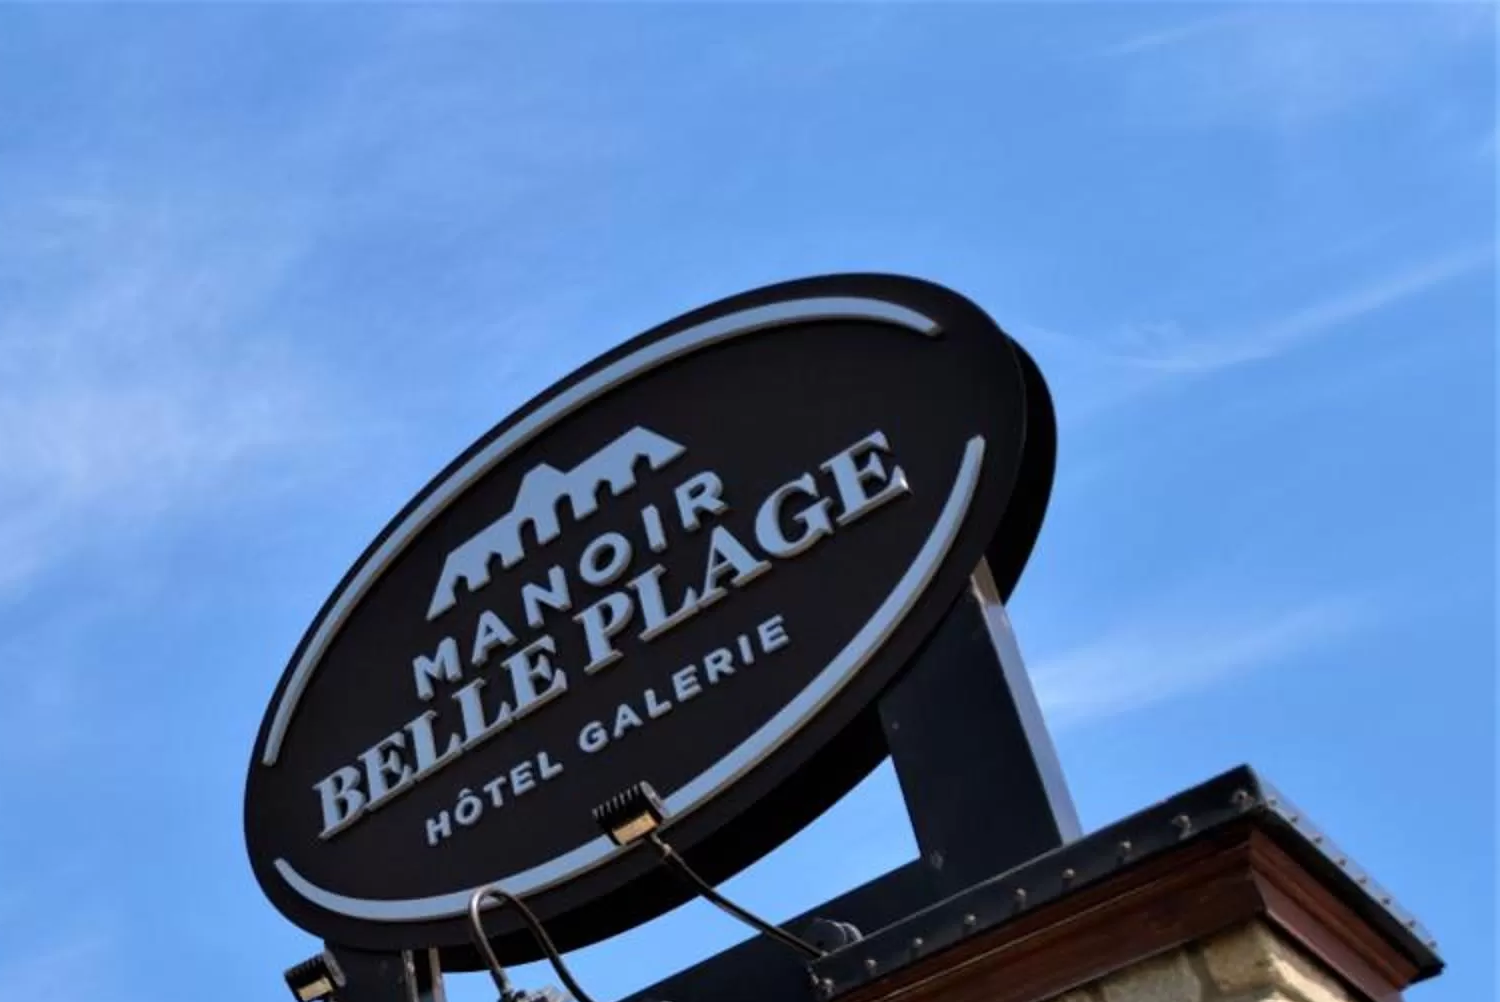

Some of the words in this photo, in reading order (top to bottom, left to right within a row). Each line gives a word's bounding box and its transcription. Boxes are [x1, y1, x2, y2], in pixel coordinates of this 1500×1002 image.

[312, 640, 568, 840] BELLE
[573, 429, 913, 675] PLAGE
[412, 469, 728, 701] MANOIR
[425, 750, 564, 845] HÔTEL
[577, 615, 791, 754] GALERIE
